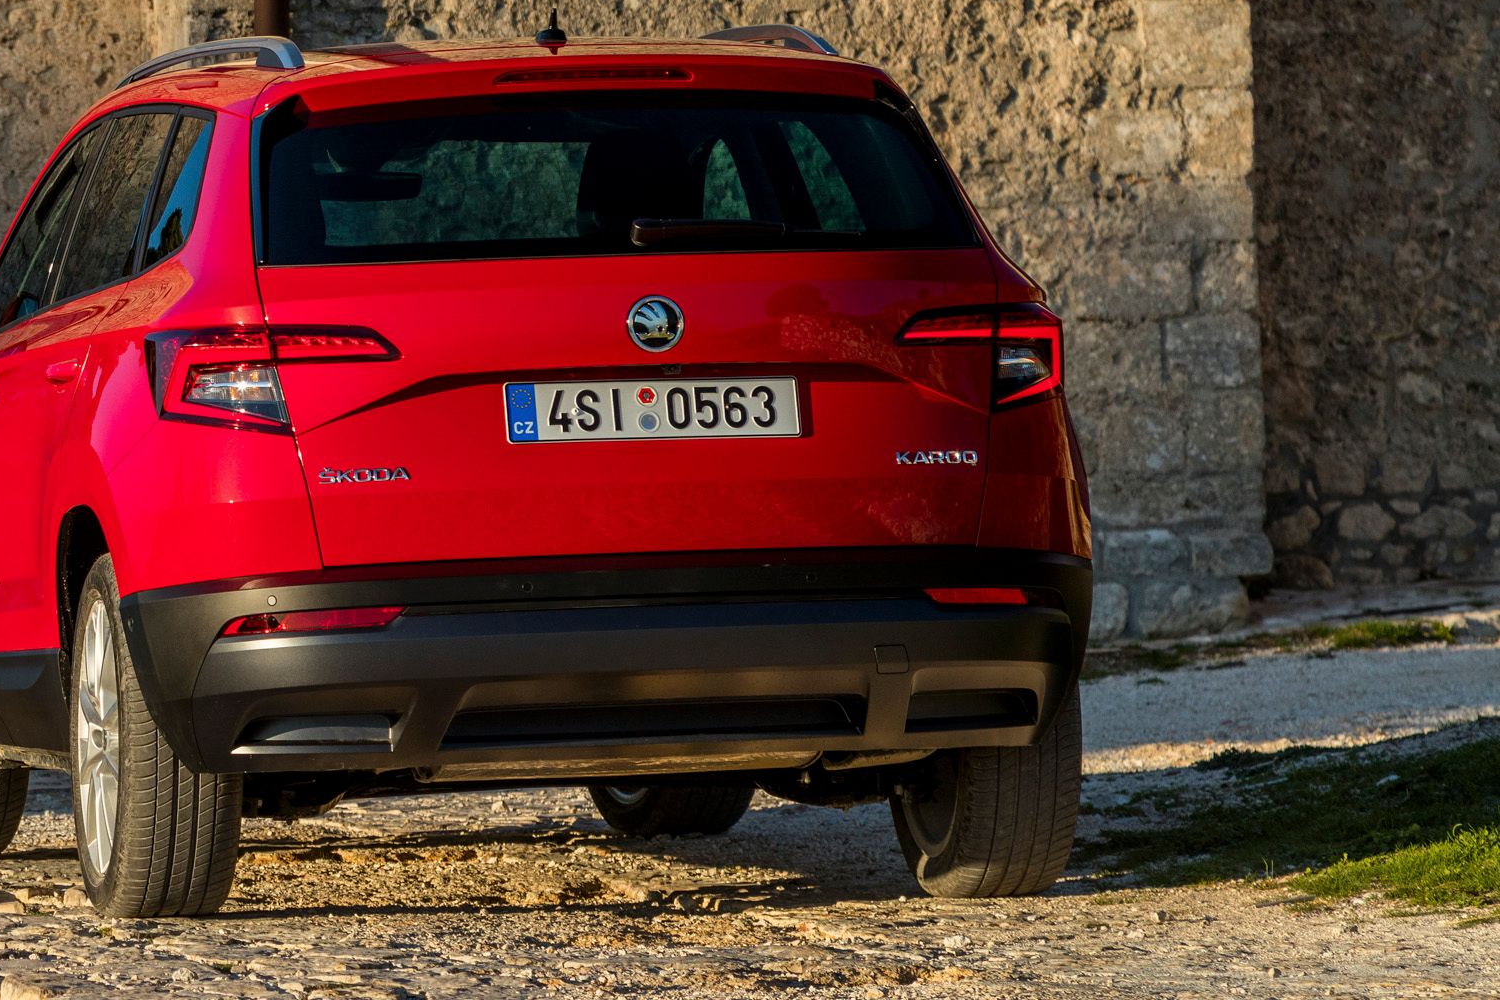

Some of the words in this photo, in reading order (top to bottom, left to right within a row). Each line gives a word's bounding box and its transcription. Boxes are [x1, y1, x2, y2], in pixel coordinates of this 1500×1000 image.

[548, 388, 623, 433] 4SI
[665, 385, 777, 430] 0563
[513, 421, 535, 434] CZ
[896, 450, 978, 466] KAROQ
[318, 467, 410, 485] ŠKODA
